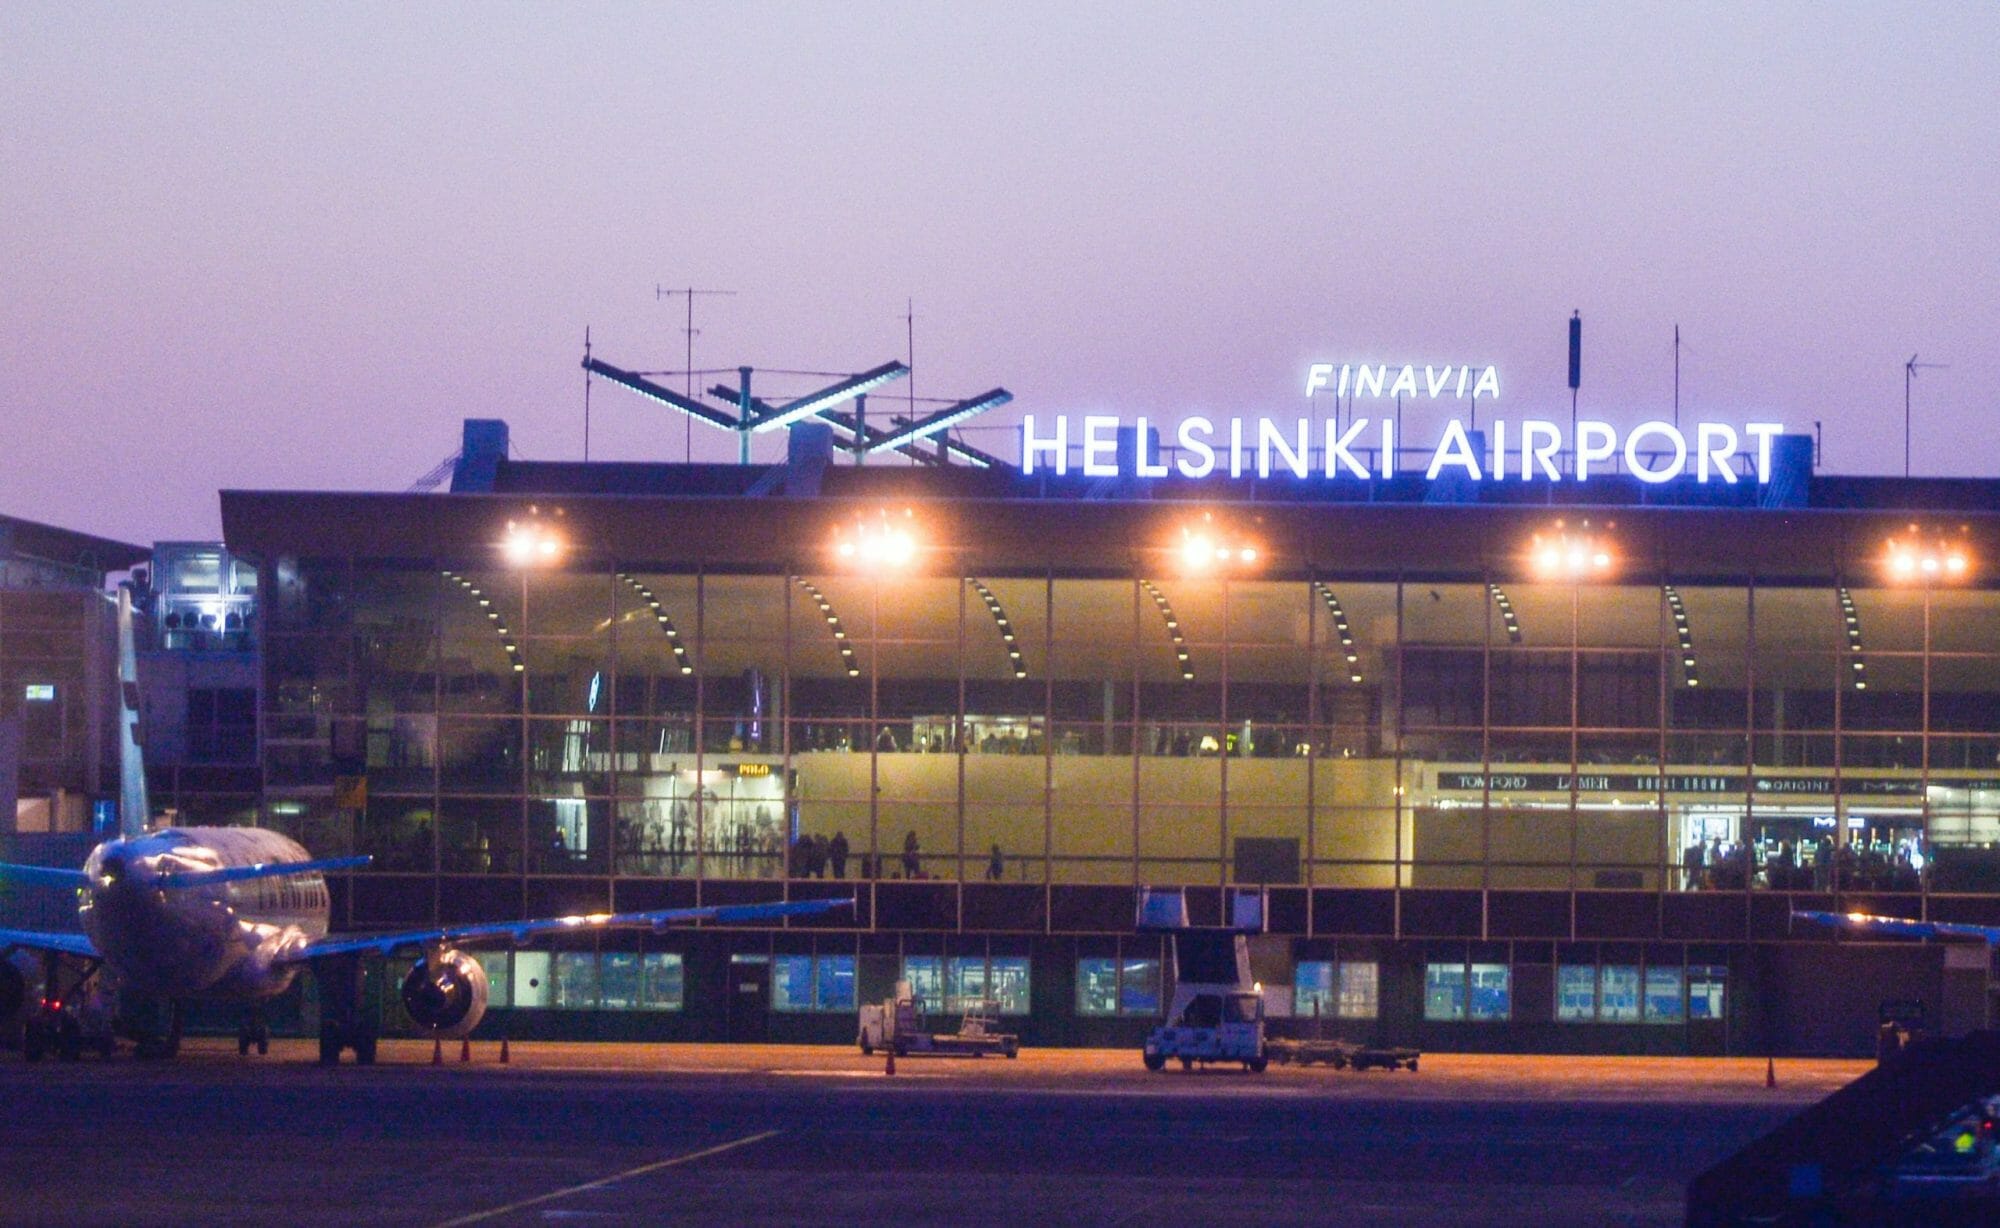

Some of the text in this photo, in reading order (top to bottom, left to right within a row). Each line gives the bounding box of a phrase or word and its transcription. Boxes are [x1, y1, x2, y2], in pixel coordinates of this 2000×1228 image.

[1305, 363, 1501, 399] FINAVIA
[1021, 414, 1785, 485] HELSINKI AIRPORT
[739, 763, 769, 776] POLO
[1459, 775, 1527, 789] TOM FORD
[1579, 776, 1609, 790] MER
[1773, 780, 1830, 792] ORIGINS
